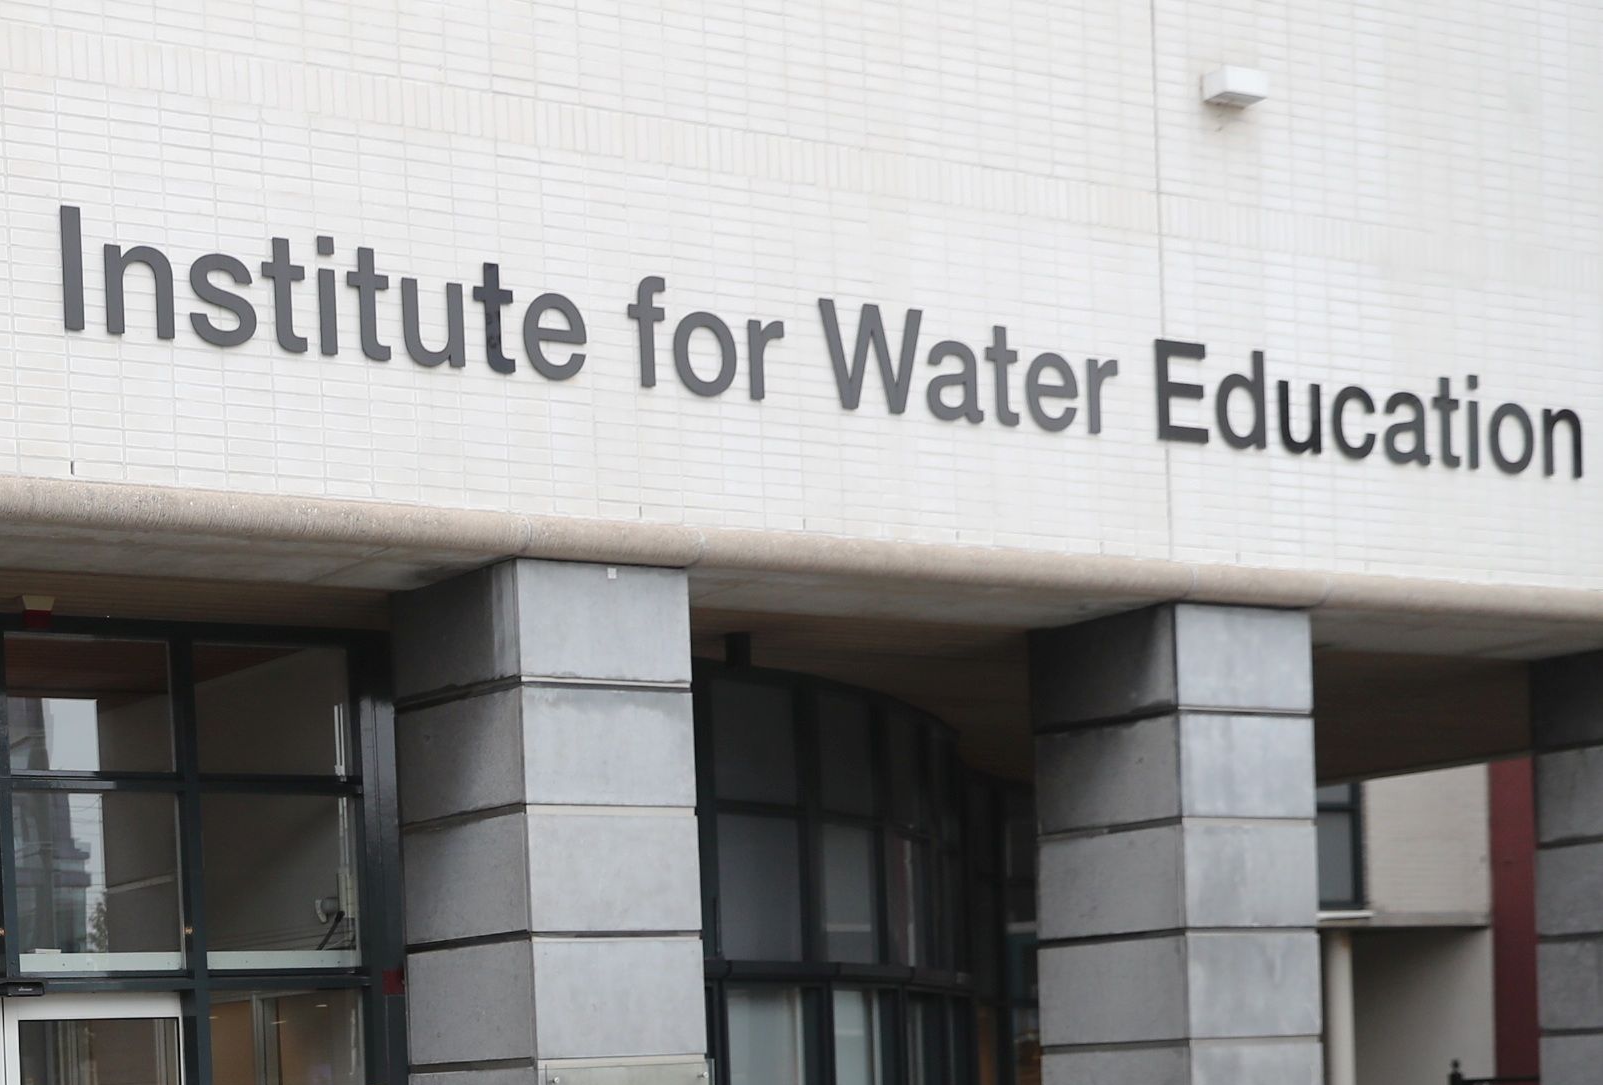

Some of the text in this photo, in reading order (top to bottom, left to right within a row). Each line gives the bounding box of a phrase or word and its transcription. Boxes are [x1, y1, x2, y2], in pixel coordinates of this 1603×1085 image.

[59, 204, 1584, 480] Institute for Water Education
